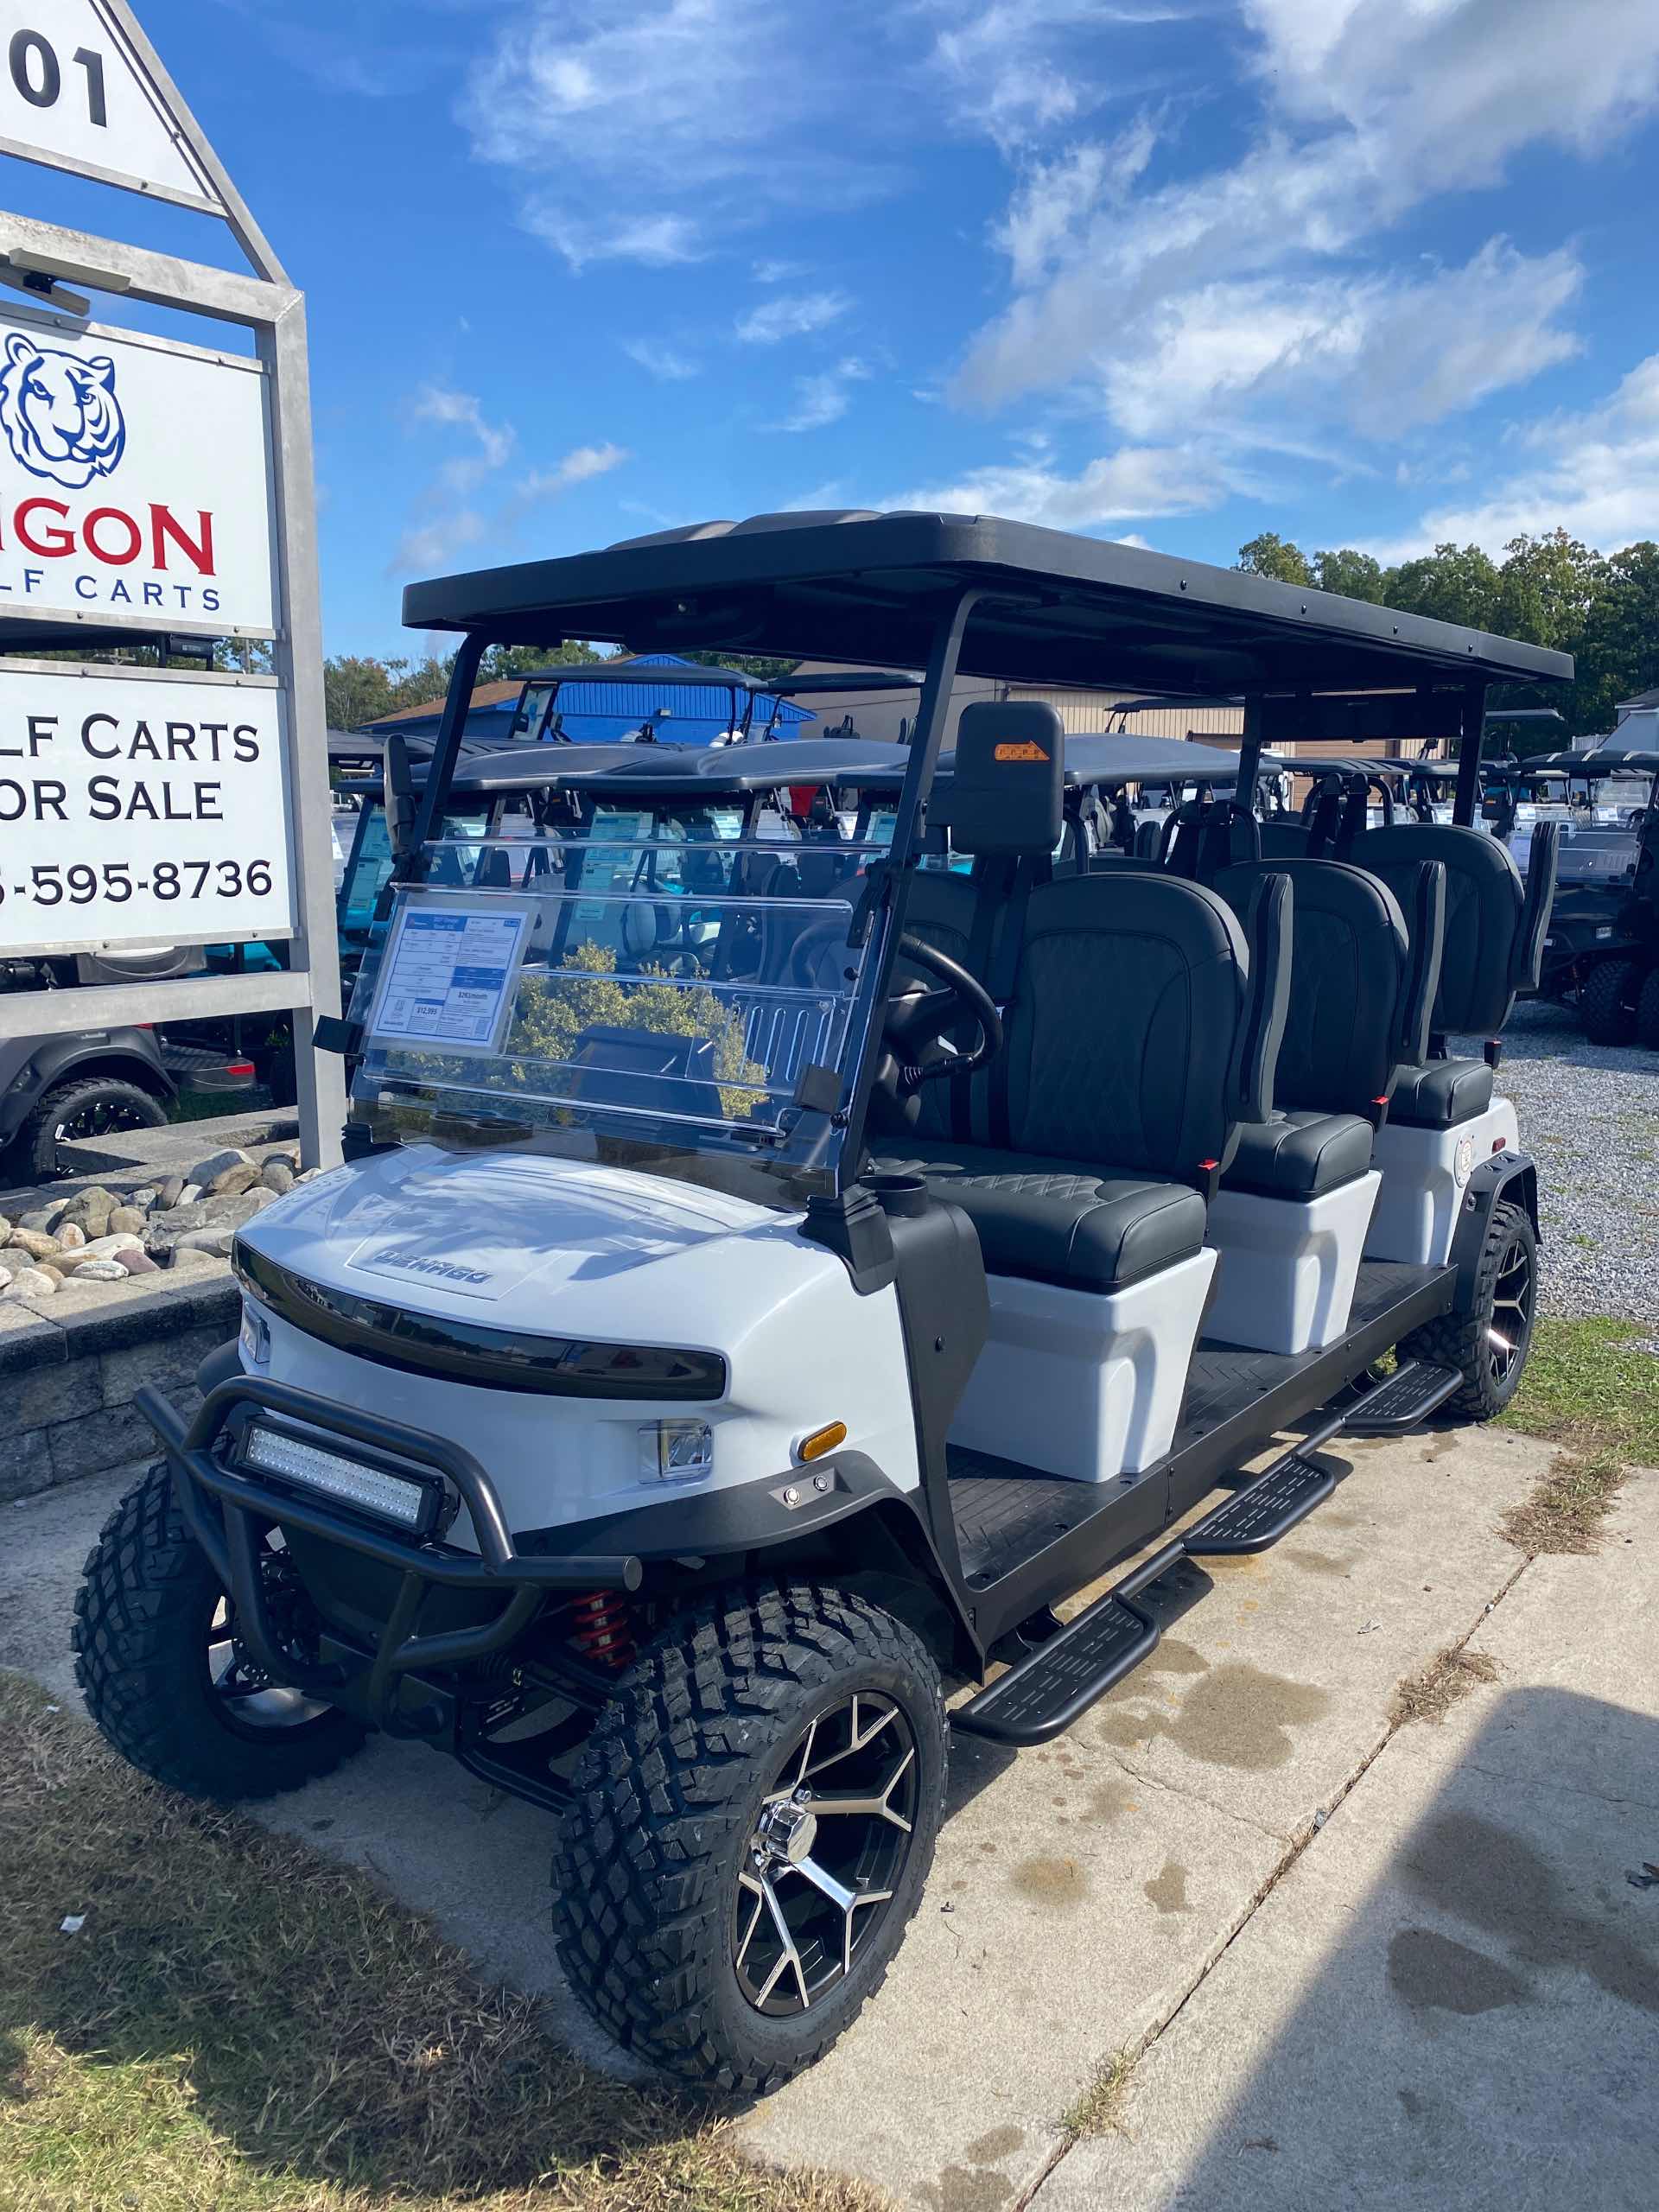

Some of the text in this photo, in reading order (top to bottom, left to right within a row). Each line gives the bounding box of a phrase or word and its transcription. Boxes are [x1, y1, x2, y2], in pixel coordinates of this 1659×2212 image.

[0, 497, 216, 576] GON
[75, 575, 220, 611] CARTS
[80, 713, 259, 762] CARTS
[87, 775, 223, 821] SALE
[0, 859, 272, 906] -595-8736
